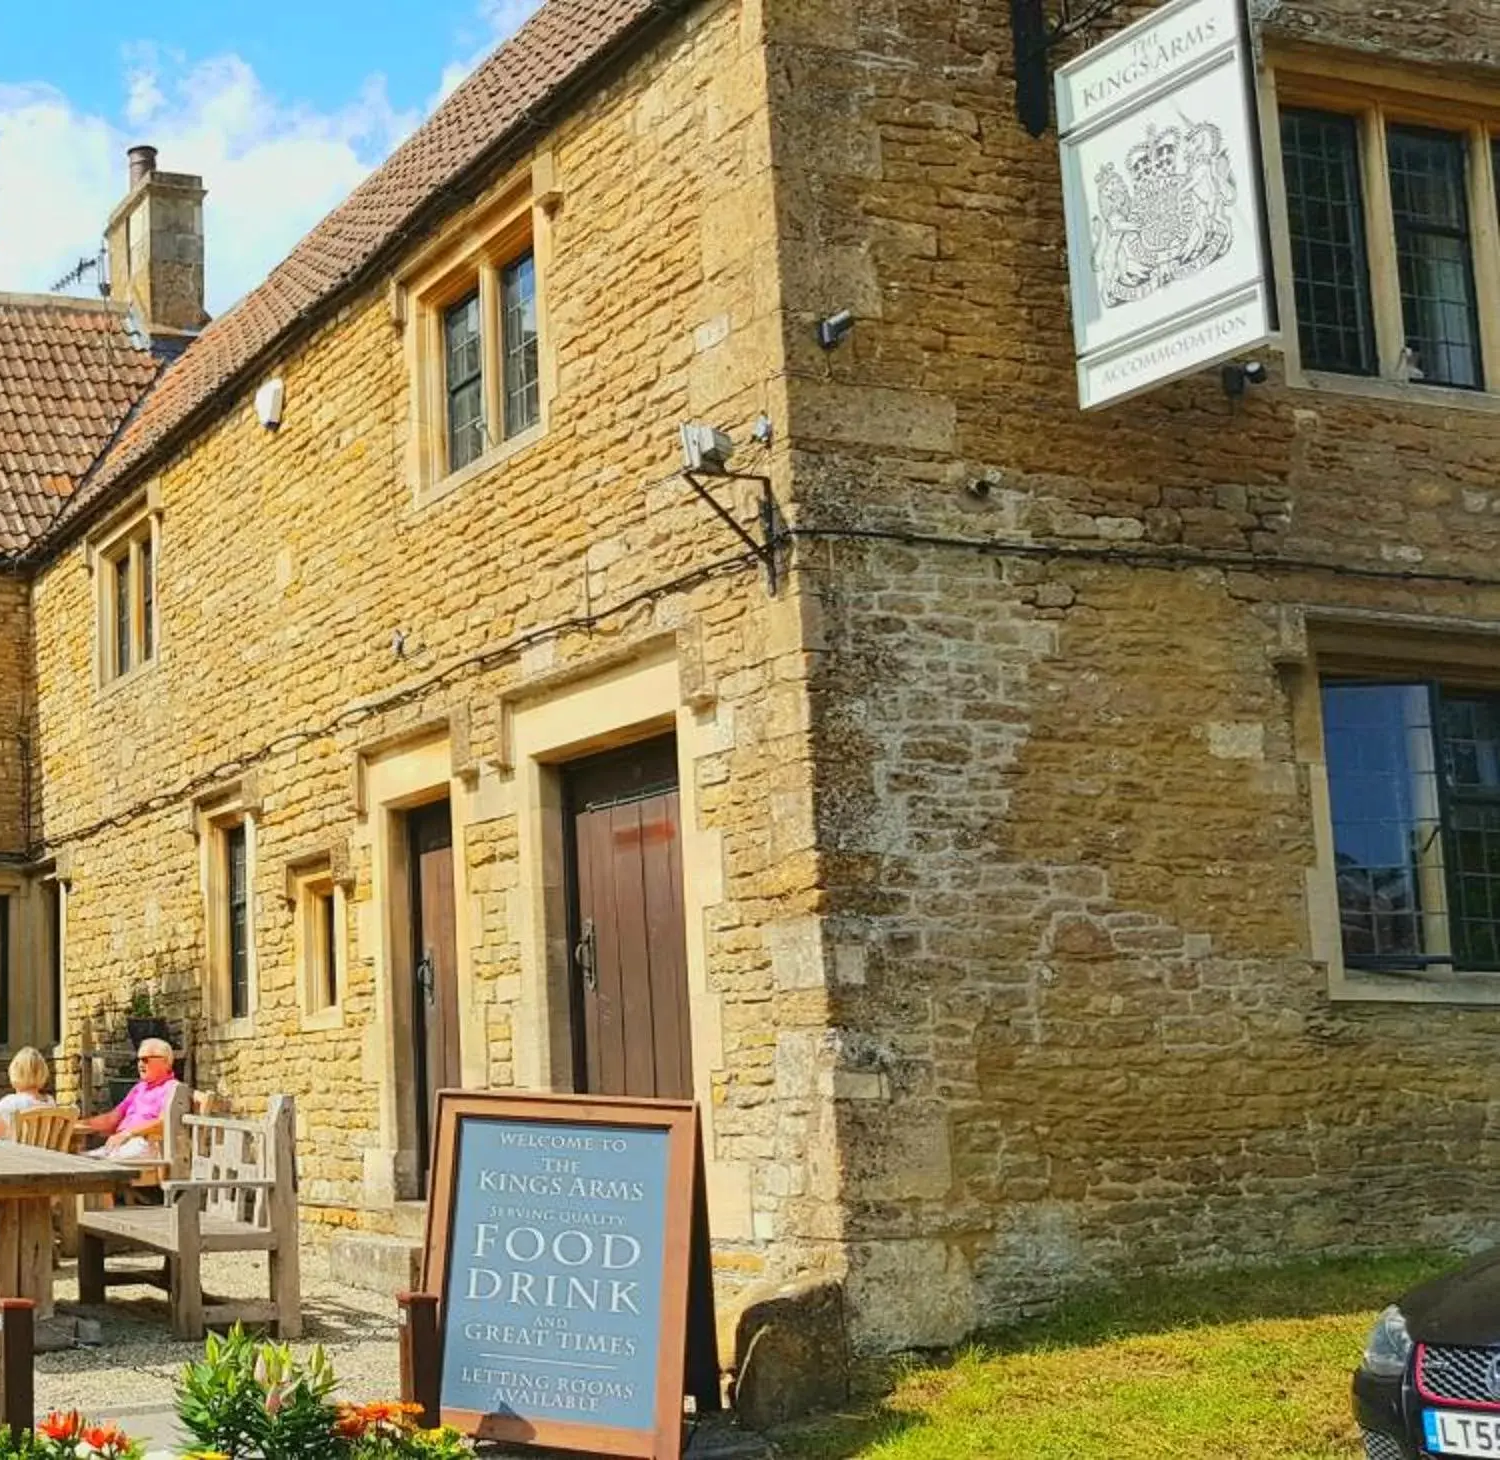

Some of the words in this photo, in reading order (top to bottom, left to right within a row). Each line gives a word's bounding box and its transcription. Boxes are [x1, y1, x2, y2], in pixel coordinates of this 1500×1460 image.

[1131, 31, 1160, 55] THE
[1082, 61, 1150, 108] KINGS
[1152, 18, 1217, 67] ARMS
[1102, 314, 1247, 386] ACCOMMODATION
[500, 1132, 593, 1151] WELCOME
[603, 1139, 627, 1153] TO
[542, 1158, 581, 1174] THE
[479, 1170, 562, 1196] KINGS
[568, 1177, 644, 1201] ARMS
[490, 1206, 554, 1221] SERVING
[559, 1211, 626, 1226] QUALITY
[473, 1223, 641, 1270] FOOD
[465, 1268, 640, 1315] DRINK
[533, 1316, 568, 1329] AND
[465, 1324, 549, 1347] GREAT
[556, 1332, 636, 1356] TIMES
[461, 1366, 549, 1389] LETTING
[557, 1377, 634, 1399] ROOMS
[492, 1389, 600, 1412] AVAILABLE
